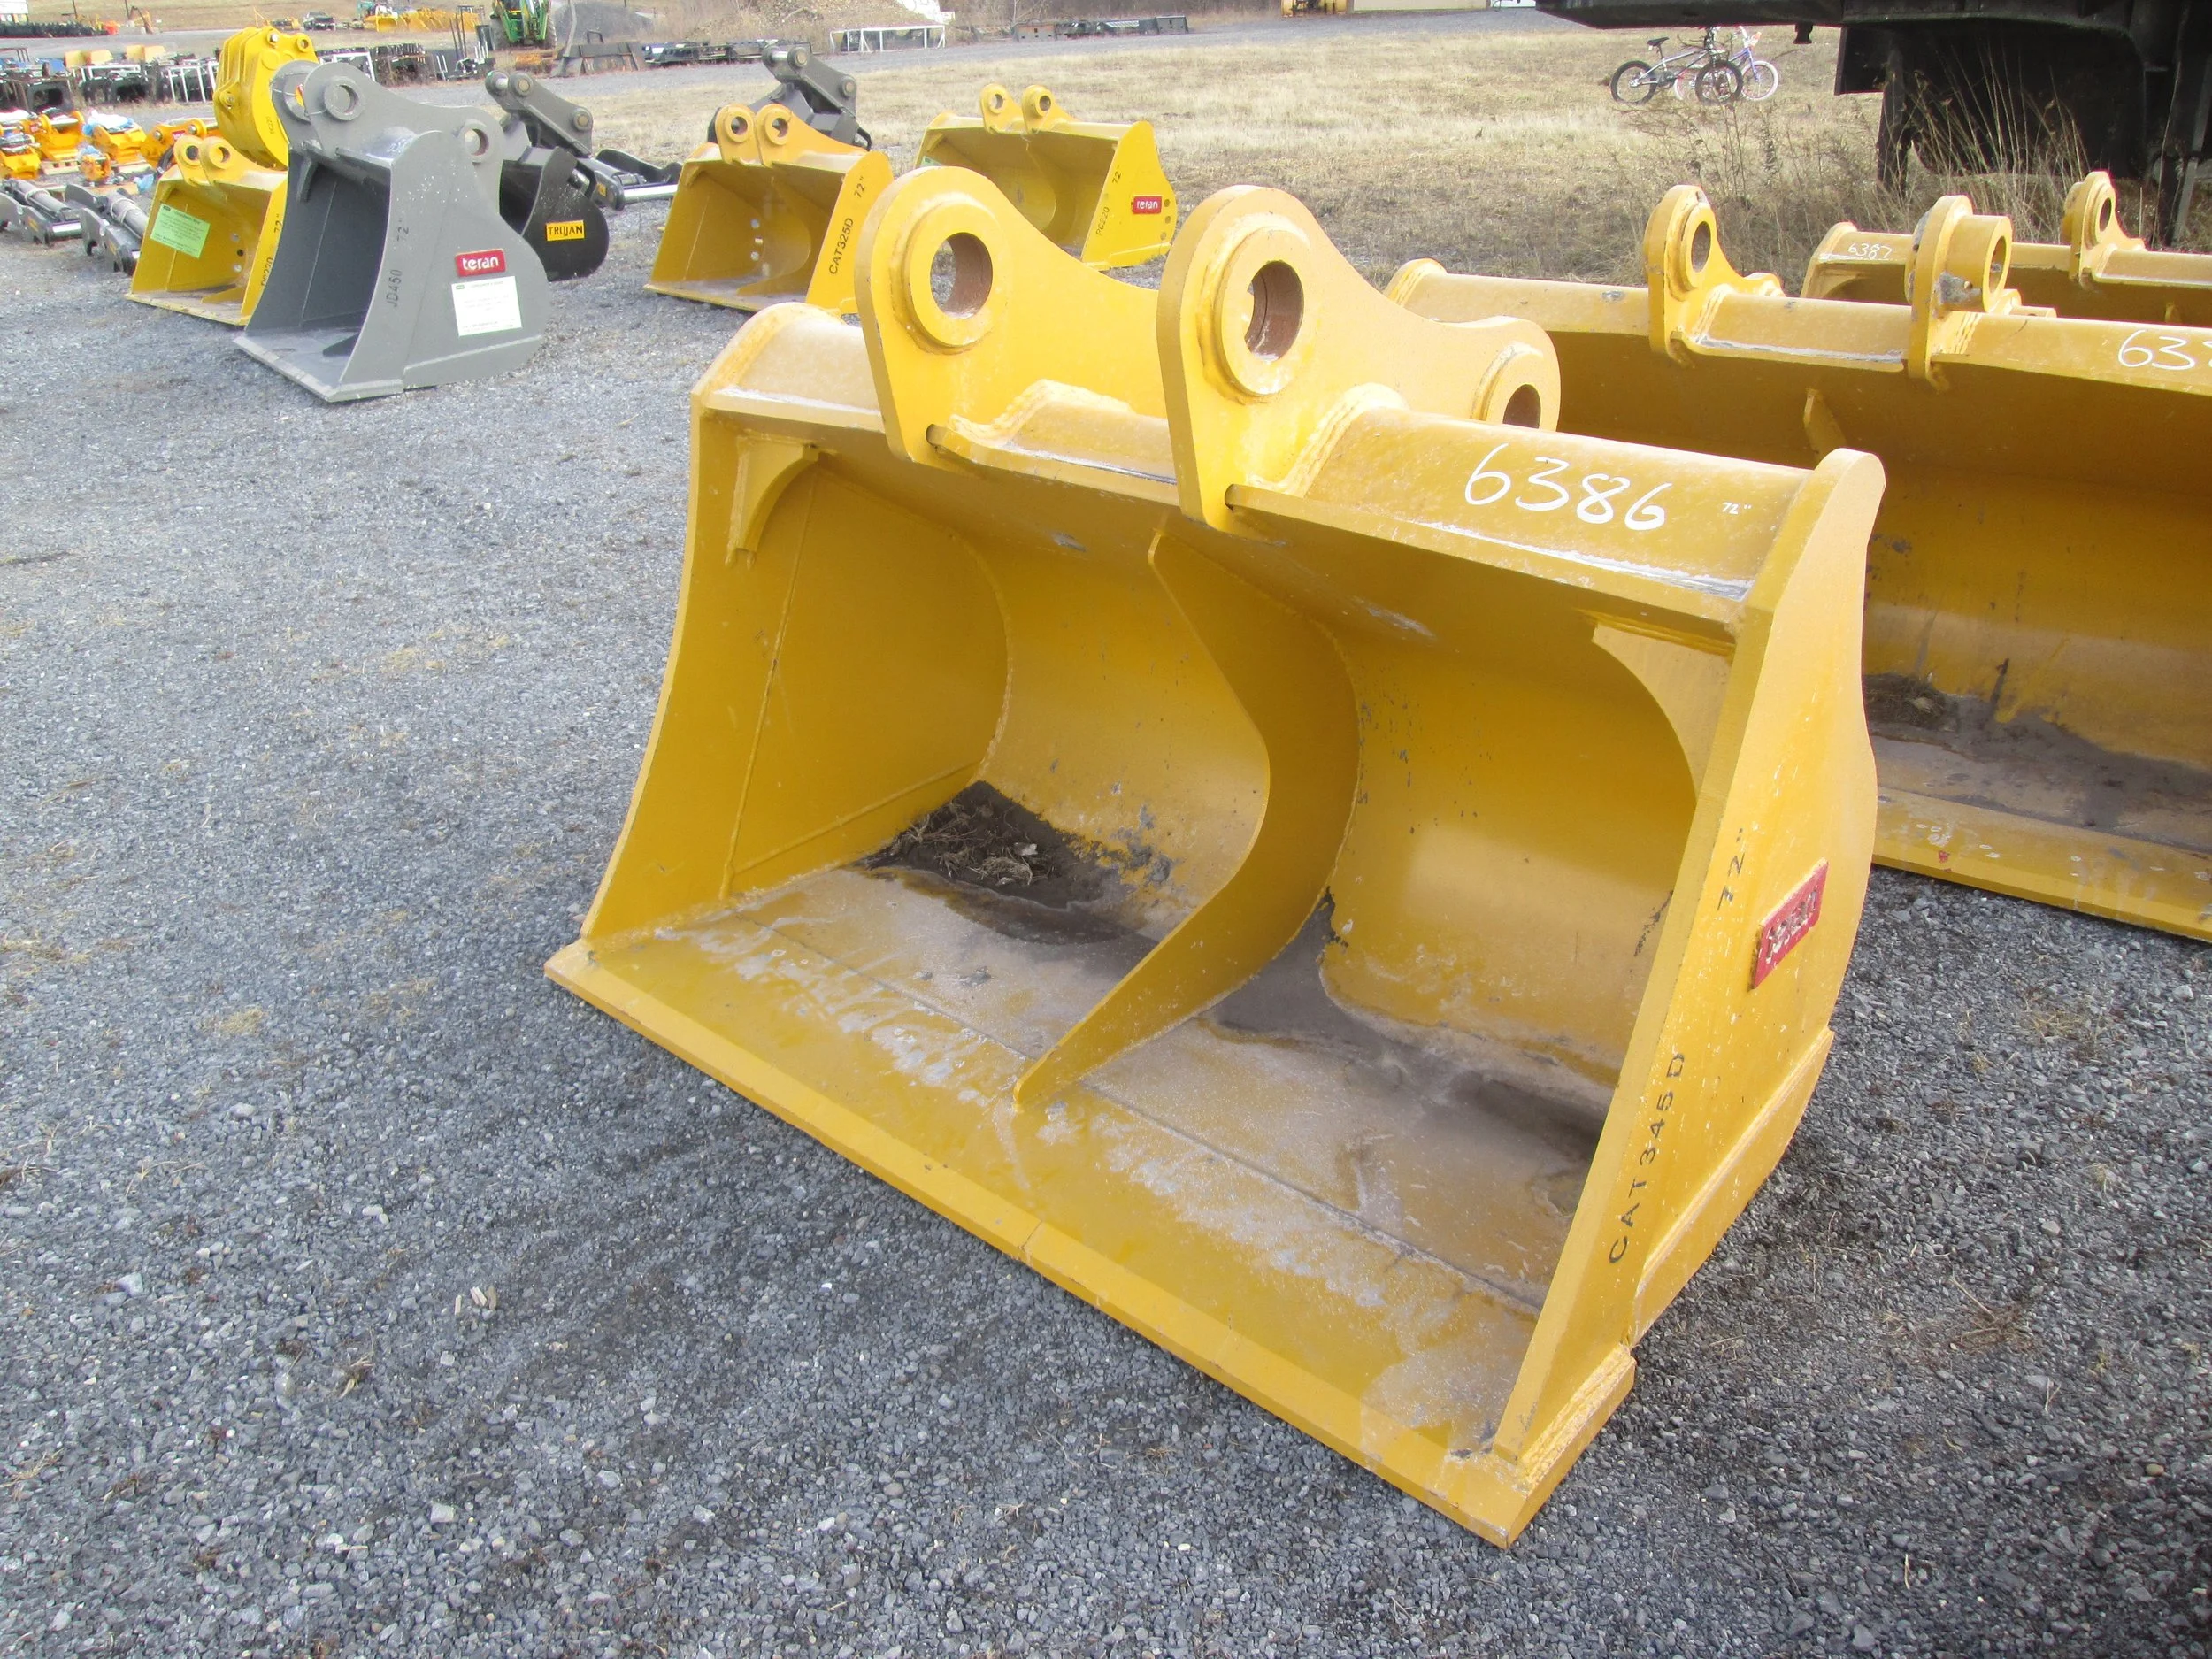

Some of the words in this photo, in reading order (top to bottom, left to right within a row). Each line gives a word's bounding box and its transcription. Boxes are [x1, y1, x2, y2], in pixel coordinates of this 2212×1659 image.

[548, 225, 583, 236] TROJAN
[828, 218, 854, 274] CAT325D
[854, 176, 865, 198] 72"
[462, 256, 499, 271] teran
[1847, 242, 1893, 260] 6387
[386, 269, 403, 307] JD450
[1464, 442, 1672, 531] 6386
[1717, 827, 1746, 911] 72"
